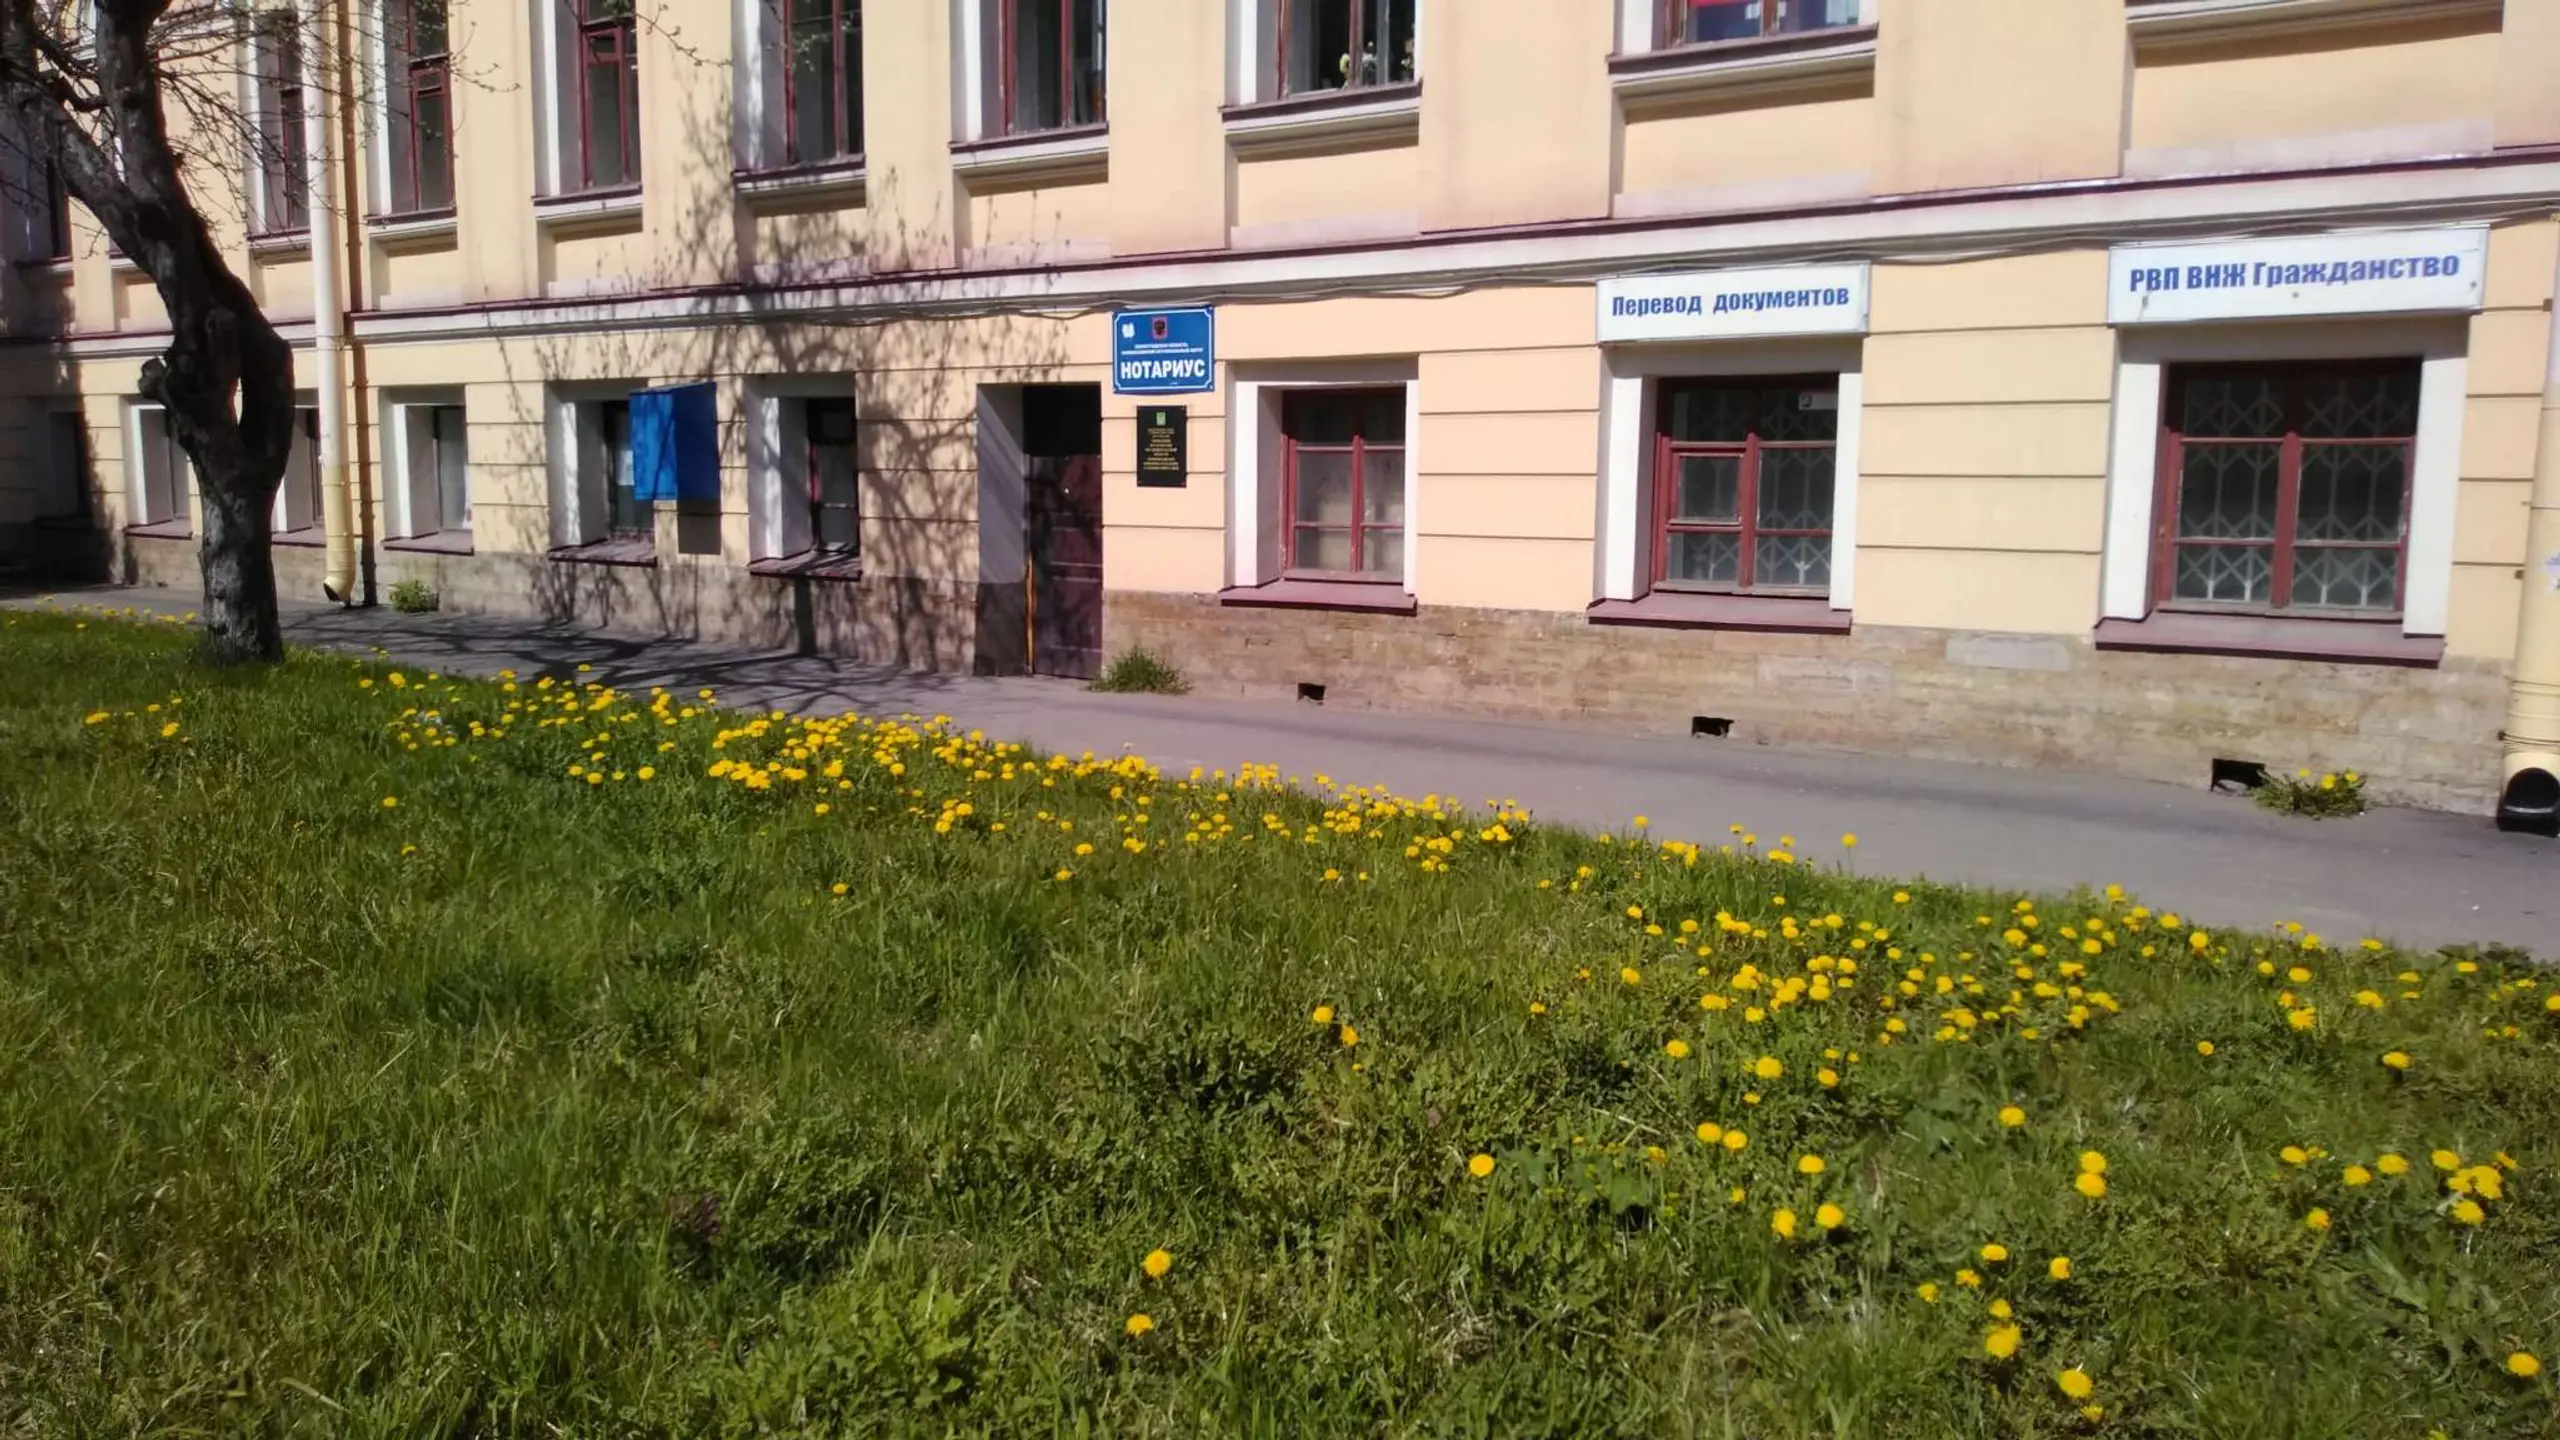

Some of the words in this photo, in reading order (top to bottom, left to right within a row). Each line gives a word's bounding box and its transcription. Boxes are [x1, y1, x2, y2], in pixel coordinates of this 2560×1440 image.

[2130, 268, 2180, 292] РВП
[2187, 263, 2246, 289] ВНЖ
[2253, 254, 2460, 288] Гражданство
[1612, 295, 1702, 317] Перевод
[1713, 287, 1850, 314] документов
[1121, 359, 1205, 379] НОТАРИУС
